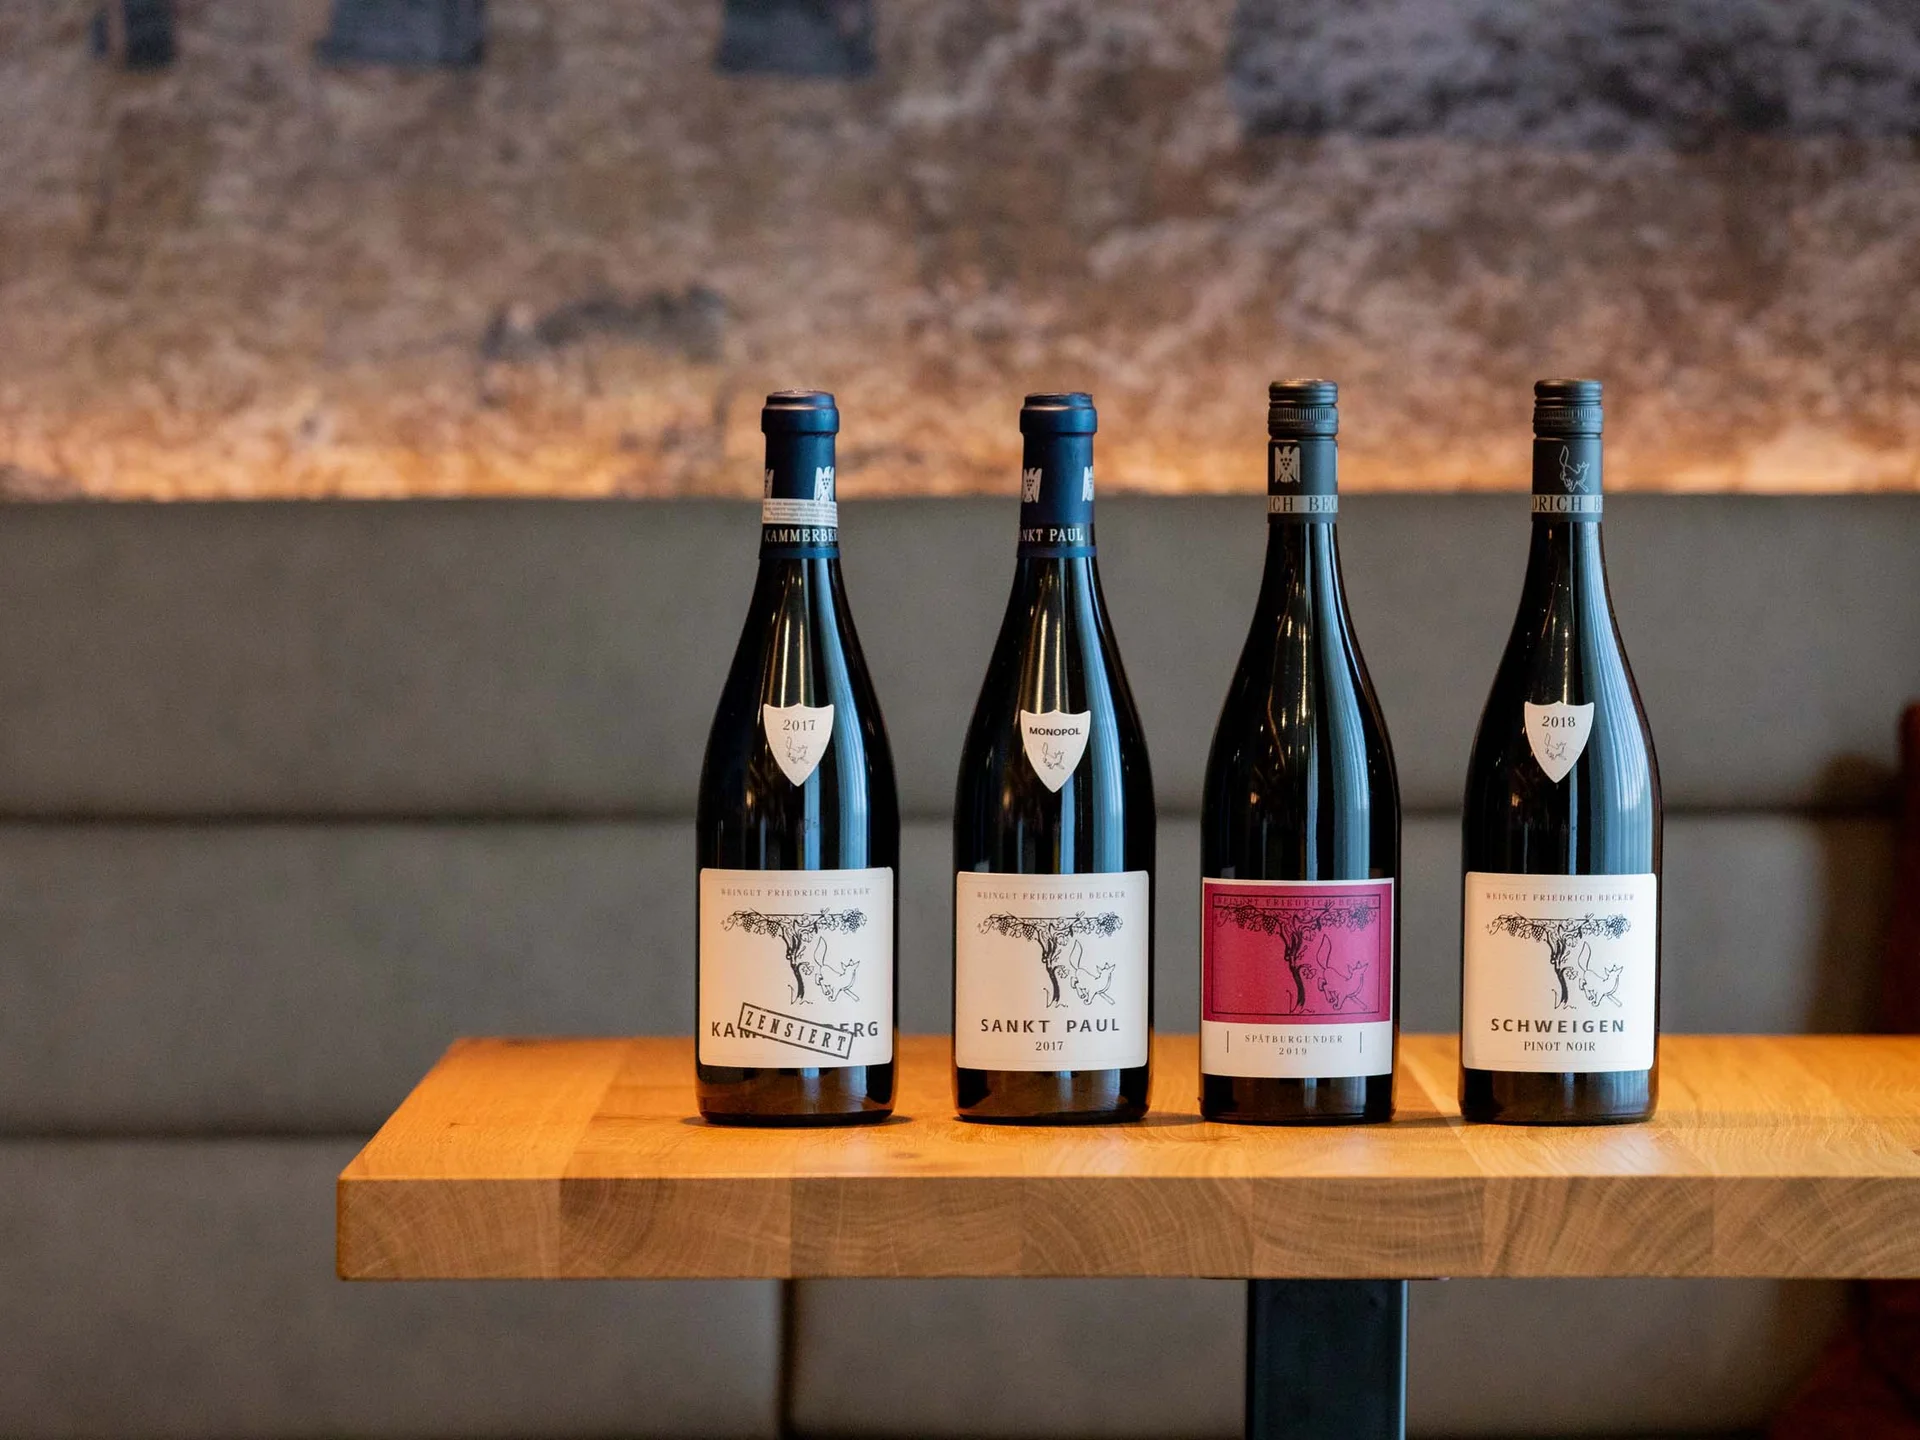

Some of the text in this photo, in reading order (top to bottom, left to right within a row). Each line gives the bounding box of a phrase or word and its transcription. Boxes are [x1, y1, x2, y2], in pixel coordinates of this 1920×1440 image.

[1049, 528, 1084, 542] PAUL
[782, 720, 816, 732] 2017
[1542, 715, 1576, 728] 2018
[1029, 727, 1081, 737] MONOPOL
[768, 888, 828, 897] FRIEDRICH
[1023, 892, 1083, 900] FRIEDRICH
[1089, 891, 1126, 900] BECKER
[1486, 892, 1527, 901] WEINGUT
[1533, 893, 1593, 902] FRIEDRICH
[745, 1010, 846, 1051] ZENSIERT
[981, 1018, 1120, 1033] SANKT PAUL
[1490, 1018, 1625, 1033] SCHWEIGEN
[1244, 1033, 1343, 1044] SPÄTBURGUNDER
[1035, 1041, 1064, 1051] 2017
[1278, 1047, 1308, 1056] 2019
[1523, 1041, 1596, 1052] PINOT NOIR
